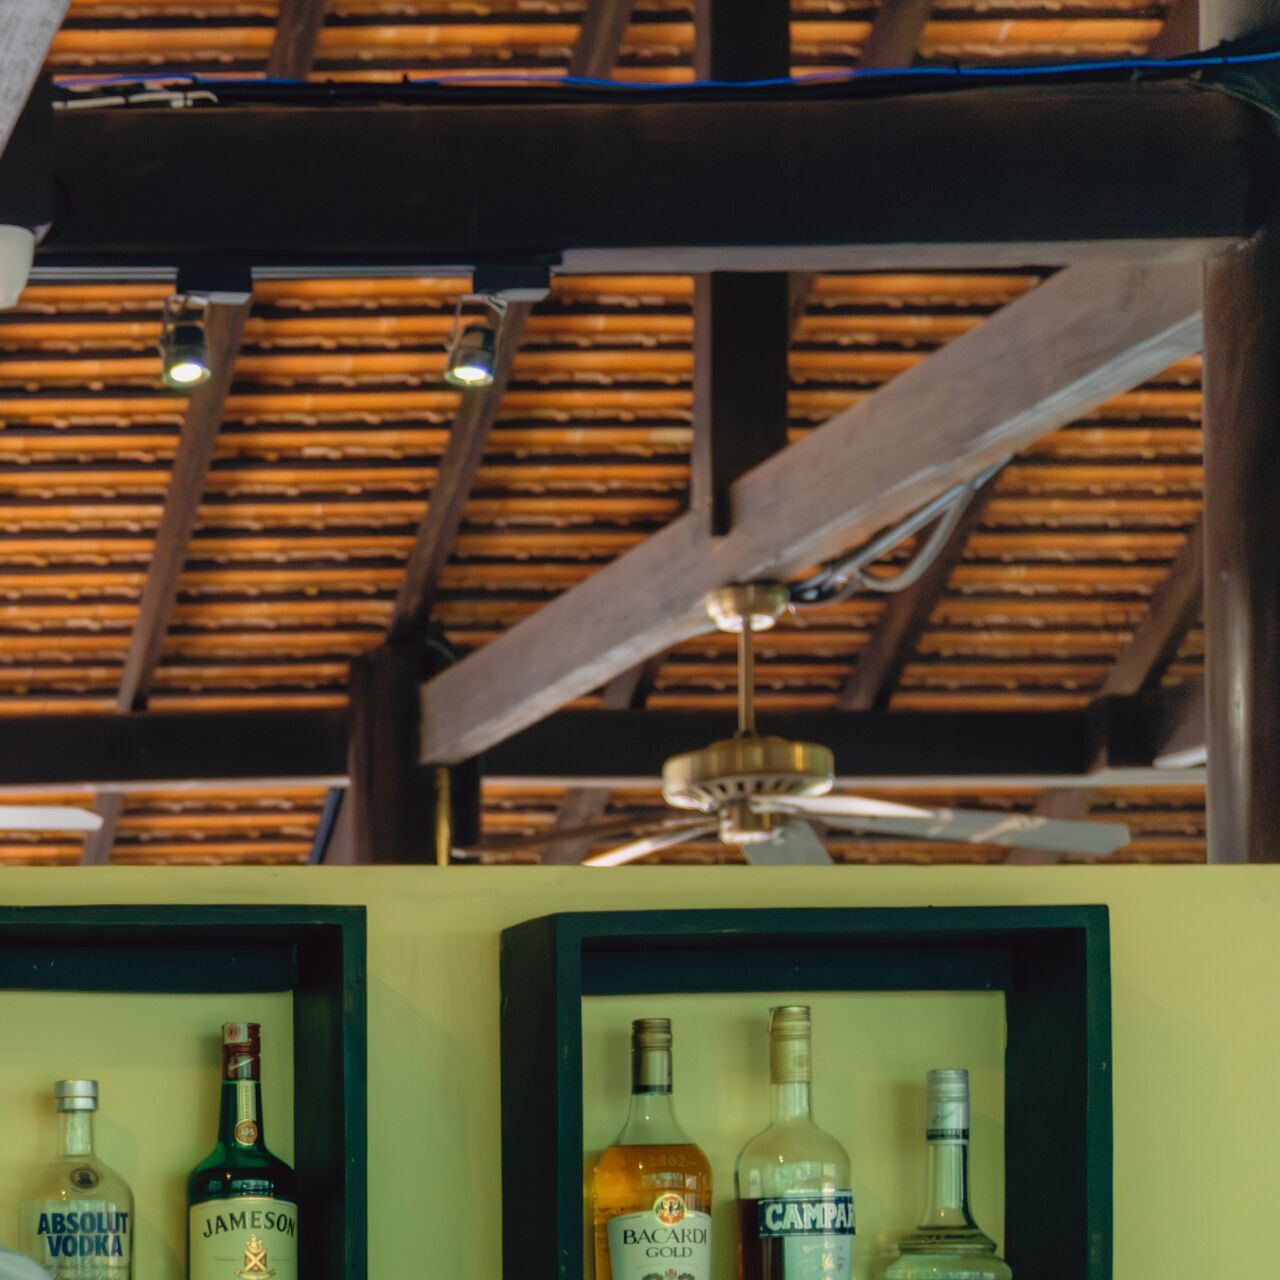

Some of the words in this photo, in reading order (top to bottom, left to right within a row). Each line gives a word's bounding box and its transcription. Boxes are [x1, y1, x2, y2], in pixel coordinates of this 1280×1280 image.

[37, 1212, 129, 1235] ABSOLUT
[203, 1211, 296, 1238] JAMESON
[765, 1202, 854, 1231] CAMPAR
[46, 1235, 124, 1258] VODKA
[623, 1229, 707, 1244] BACARDI
[645, 1246, 693, 1258] GOLD
